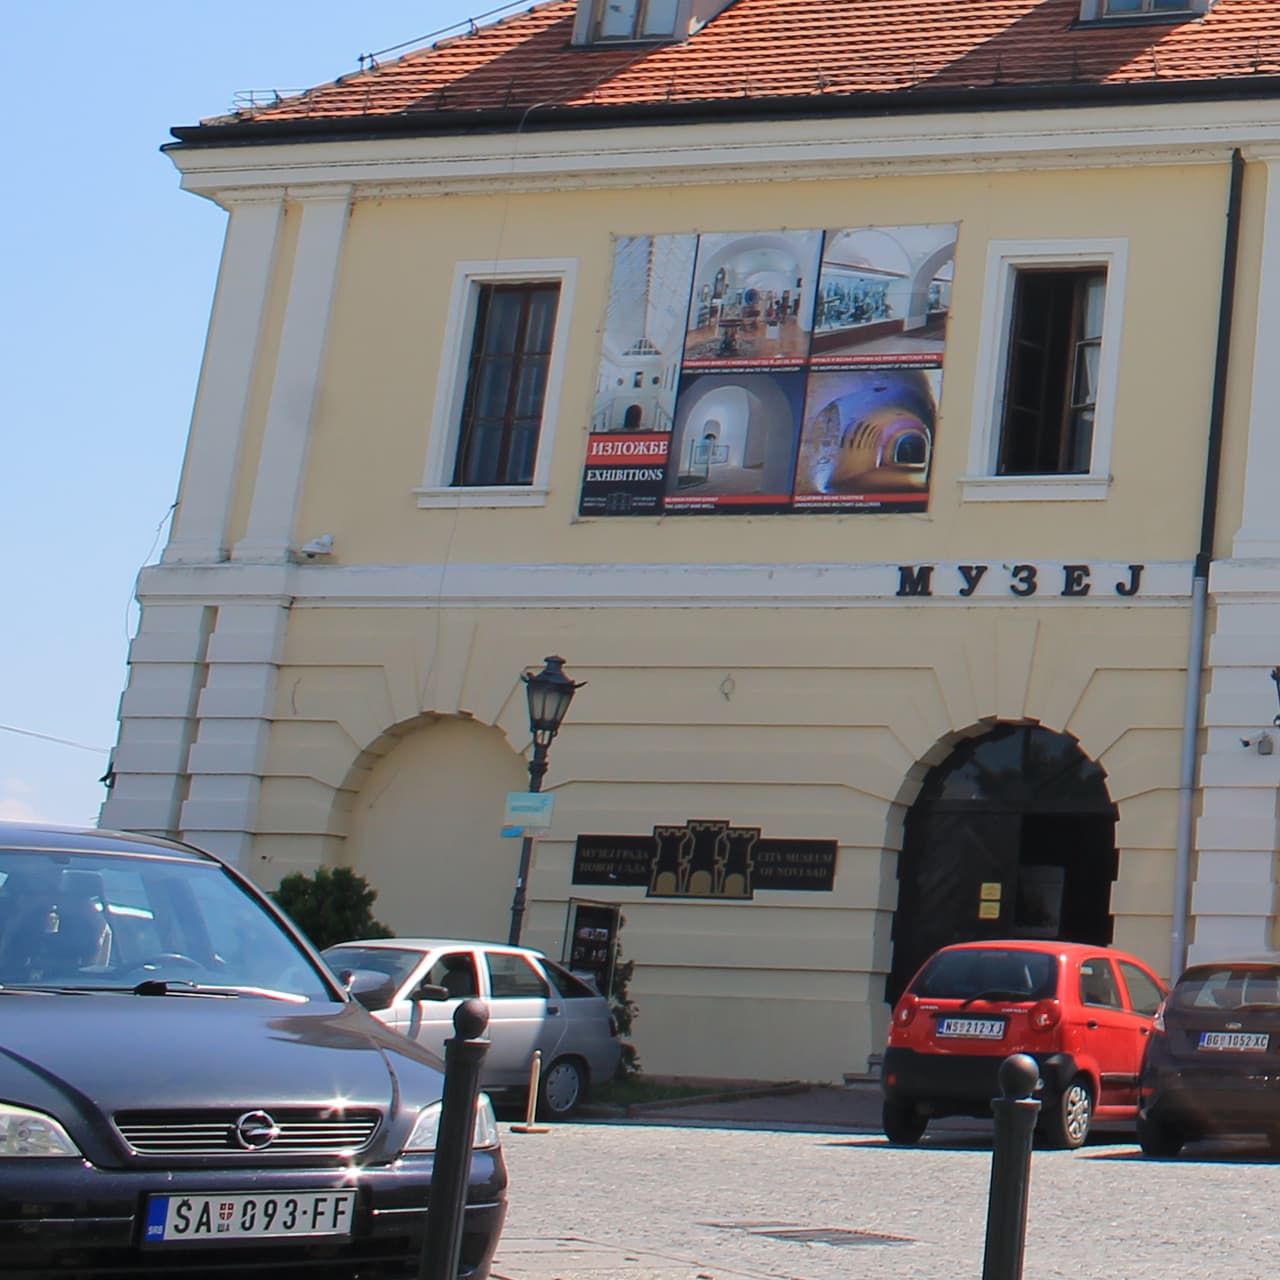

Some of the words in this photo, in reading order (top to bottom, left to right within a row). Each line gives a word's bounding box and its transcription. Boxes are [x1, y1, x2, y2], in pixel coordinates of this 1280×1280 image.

[591, 441, 668, 456] ИЗЛОЖБЕ
[586, 468, 663, 481] EXHIBITIONS
[945, 1021, 959, 1033] NS
[174, 1198, 211, 1234] ŠA
